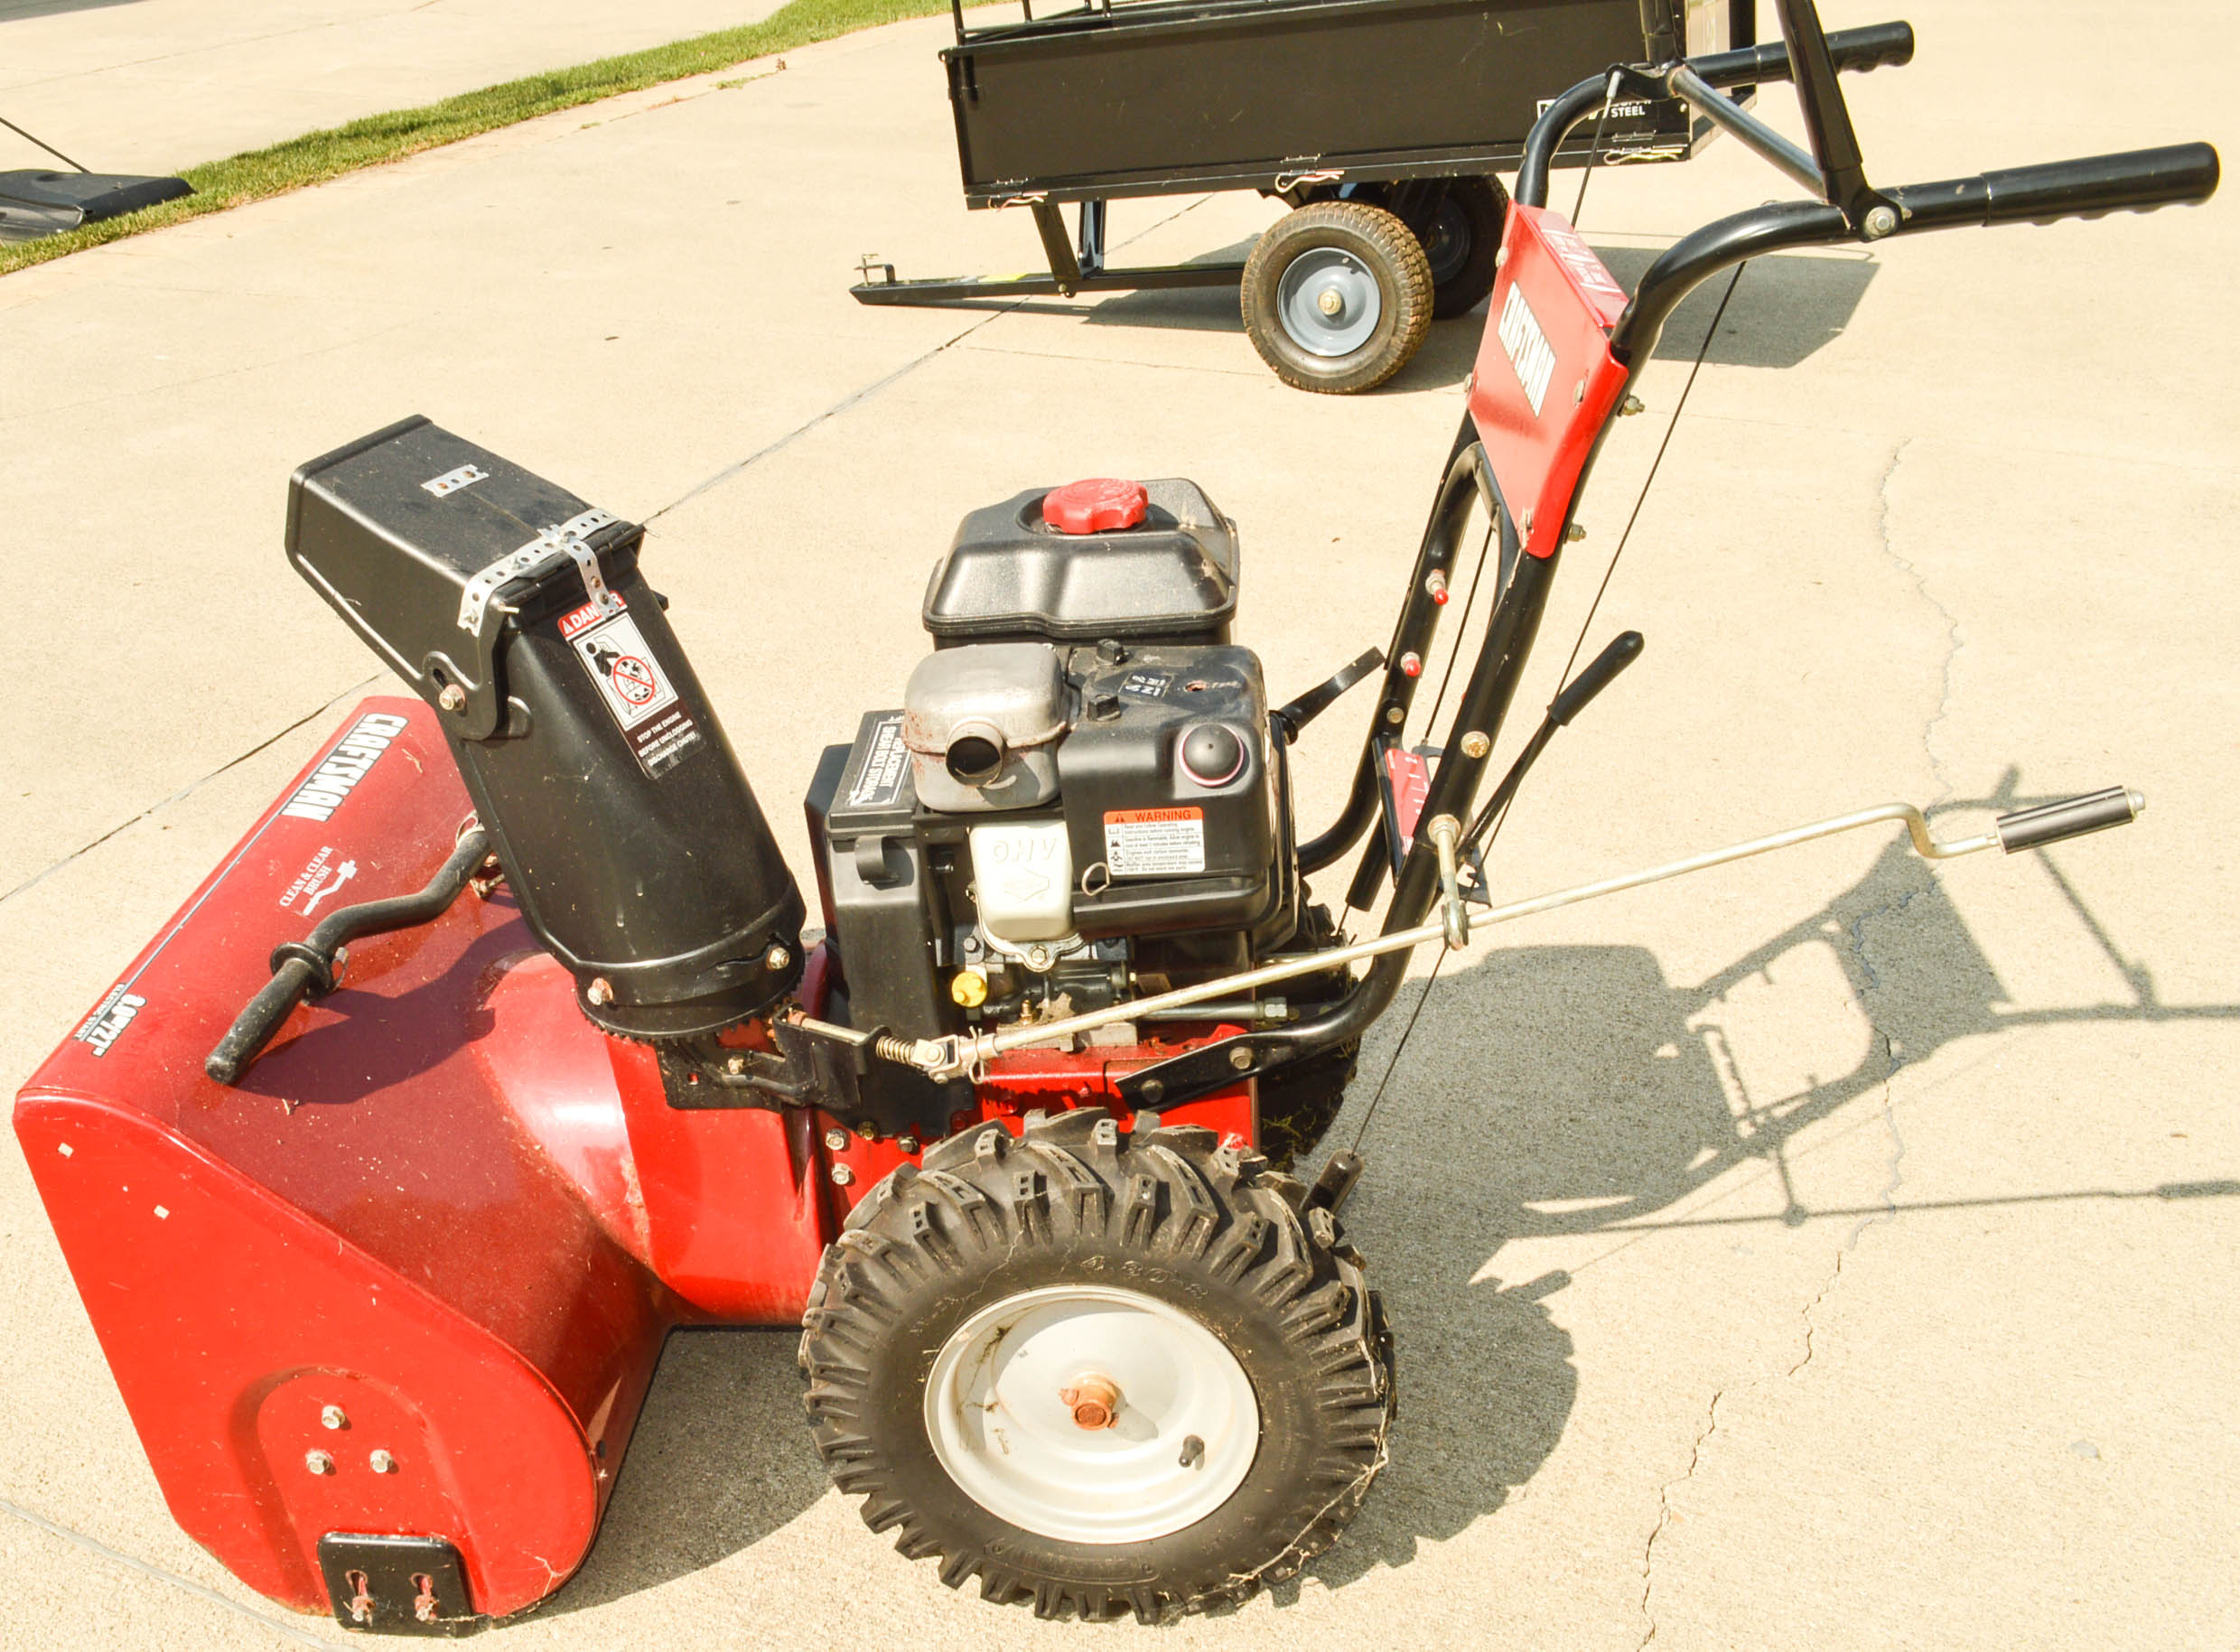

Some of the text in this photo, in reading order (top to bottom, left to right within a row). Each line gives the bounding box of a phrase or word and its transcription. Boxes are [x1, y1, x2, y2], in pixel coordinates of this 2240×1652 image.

[1610, 106, 1646, 118] STEEL
[569, 593, 622, 630] DANR
[637, 711, 682, 743] STOP THE ENGINE
[638, 718, 694, 758] BEFORE UNCLOGGING
[877, 725, 897, 751] SHEAR
[282, 713, 409, 823] CRAFTSMAN
[871, 749, 890, 769] BOLT
[1134, 809, 1192, 823] WARNING
[992, 836, 1058, 863] OHV
[279, 845, 333, 907] CLEAN & CLEAR
[303, 864, 333, 896] BRUSH
